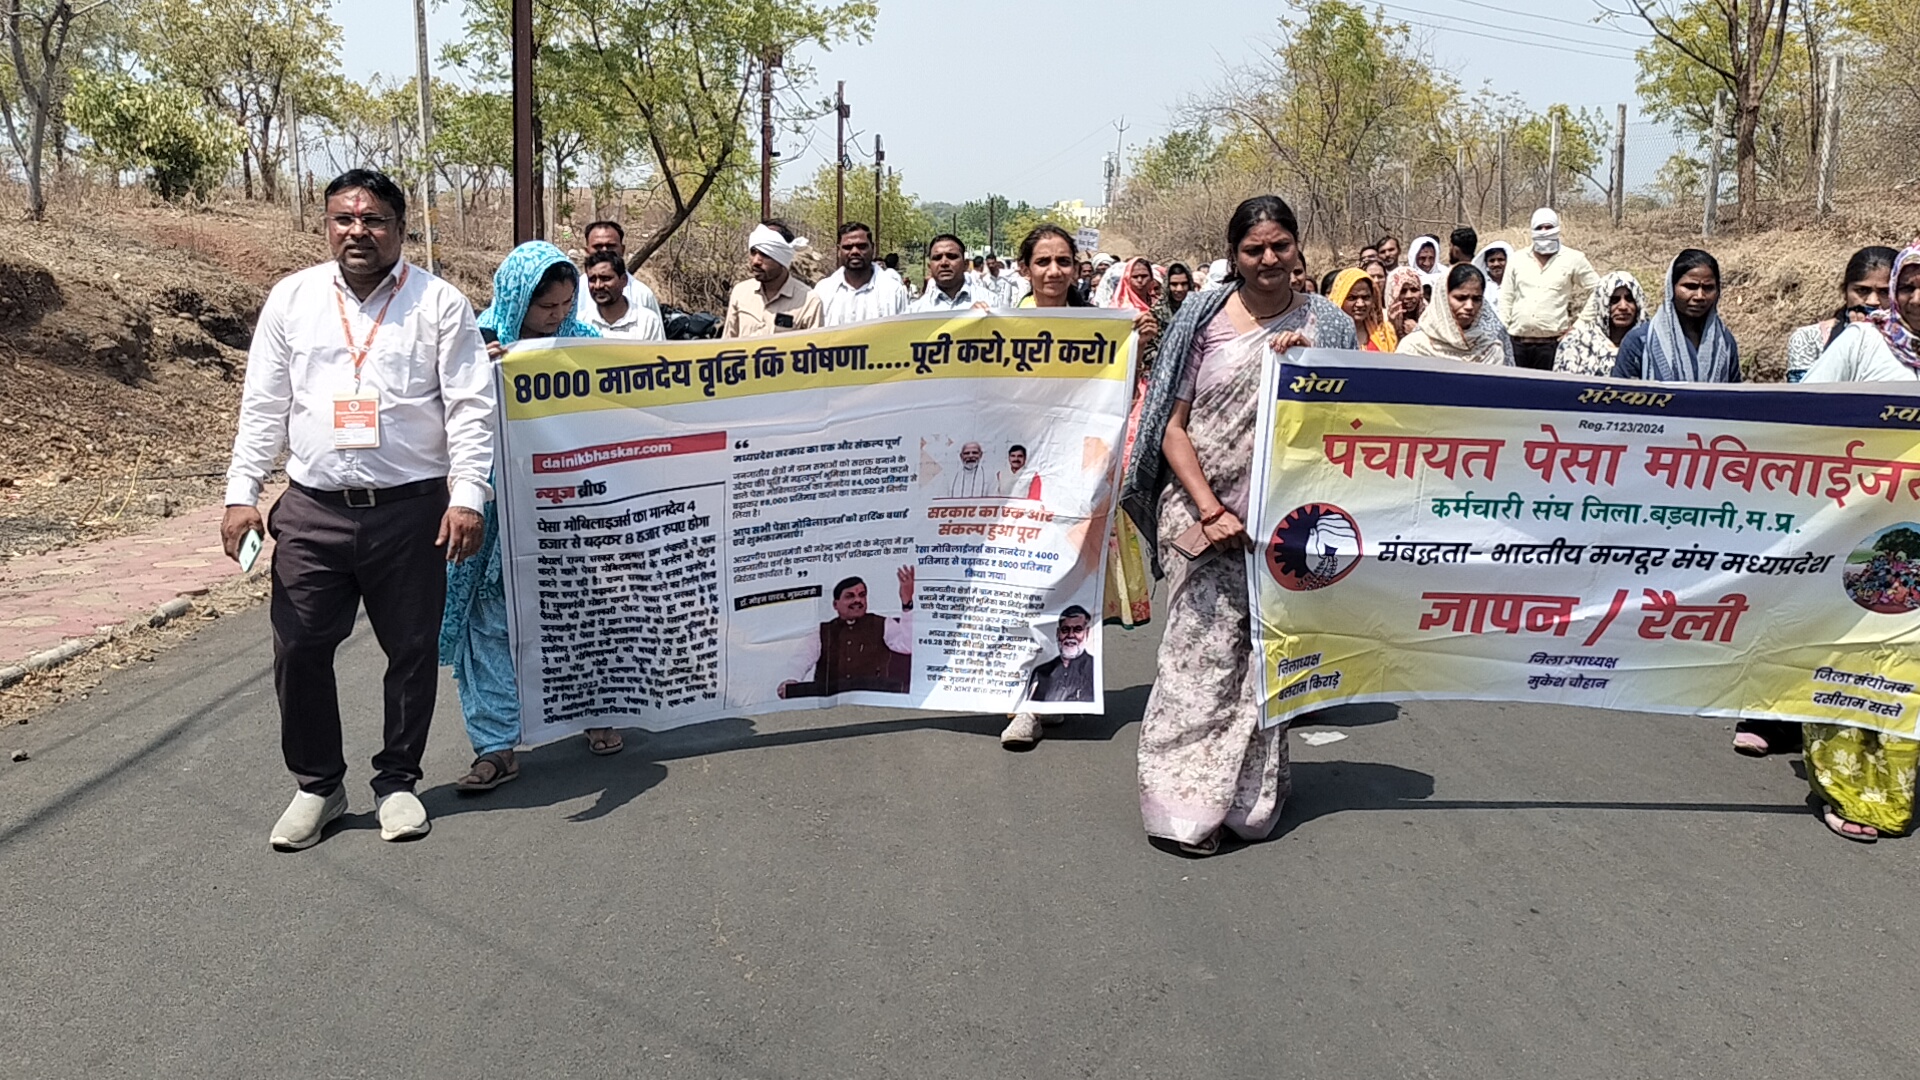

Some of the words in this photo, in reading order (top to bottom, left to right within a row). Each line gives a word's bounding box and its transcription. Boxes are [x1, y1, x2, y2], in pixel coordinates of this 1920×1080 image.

[514, 368, 590, 403] 8000
[597, 356, 692, 394] मानदेय
[697, 350, 749, 397] वृद्धि
[753, 347, 786, 378] कि
[1058, 333, 1117, 364] करो।
[1289, 372, 1349, 394] सेवा
[1578, 386, 1677, 409] संस्कार
[1578, 419, 1665, 435] Reg.7123/2024
[542, 443, 672, 469] dainikbhaskar.com
[775, 447, 805, 458] सरकार
[806, 445, 819, 453] का
[820, 443, 835, 452] एक
[838, 440, 853, 450] और
[854, 439, 884, 449] संकल्प
[885, 436, 902, 450] पूर्ण
[1322, 418, 1505, 481] पंचायत
[1523, 424, 1628, 486] पेसा
[535, 486, 576, 504] न्यूज
[576, 479, 607, 498] ब्रीफ
[537, 517, 560, 532] पेसा
[563, 508, 631, 531] मोबिलाइजर्स
[632, 509, 648, 523] का
[648, 499, 686, 519] मानदेय
[687, 500, 696, 511] 4
[928, 506, 977, 518] सरकार
[979, 506, 1000, 518] का
[1001, 506, 1026, 519] एक
[1431, 491, 1524, 520] कर्मचारी
[1532, 494, 1573, 522] संघ
[538, 538, 569, 550] हजार
[569, 533, 582, 549] से
[582, 534, 623, 549] बढ़कर
[625, 532, 634, 545] 8
[636, 526, 661, 543] हजार
[661, 520, 686, 536] रुपए
[688, 514, 710, 531] होगा
[733, 527, 750, 536] आप
[752, 522, 770, 534] सभी
[772, 521, 790, 531] पेसा
[846, 513, 857, 522] को
[859, 511, 884, 522] हार्दिक
[886, 508, 909, 519] बधाई
[938, 520, 986, 535] संकल्प
[988, 524, 1015, 540] हुआ
[1017, 526, 1042, 544] पूरा
[918, 555, 950, 566] प्रतिमाह
[951, 555, 960, 565] से
[998, 560, 1018, 569] 8000
[985, 546, 996, 554] का
[1035, 552, 1059, 560] 4000
[1491, 537, 1587, 565] भारतीय
[1589, 545, 1670, 575] मजदूर
[1672, 543, 1718, 571] संघ
[1721, 551, 1835, 576] मध्यप्रदेश
[965, 568, 986, 578] किया
[1418, 592, 1580, 637] ज्ञापन
[1638, 587, 1750, 643] रैली
[1278, 653, 1321, 677] जिलाध्यक्ष
[1528, 652, 1566, 665] जिला
[1565, 655, 1619, 669] उपाध्यक्ष
[1278, 680, 1307, 700] बलराम
[1309, 671, 1341, 691] किराड़े
[1528, 673, 1568, 690] मुकेश
[1813, 667, 1852, 684] जिला
[1853, 673, 1914, 694] संयोजक
[1813, 691, 1867, 710] दसीराम
[1868, 700, 1903, 717] सस्ते
